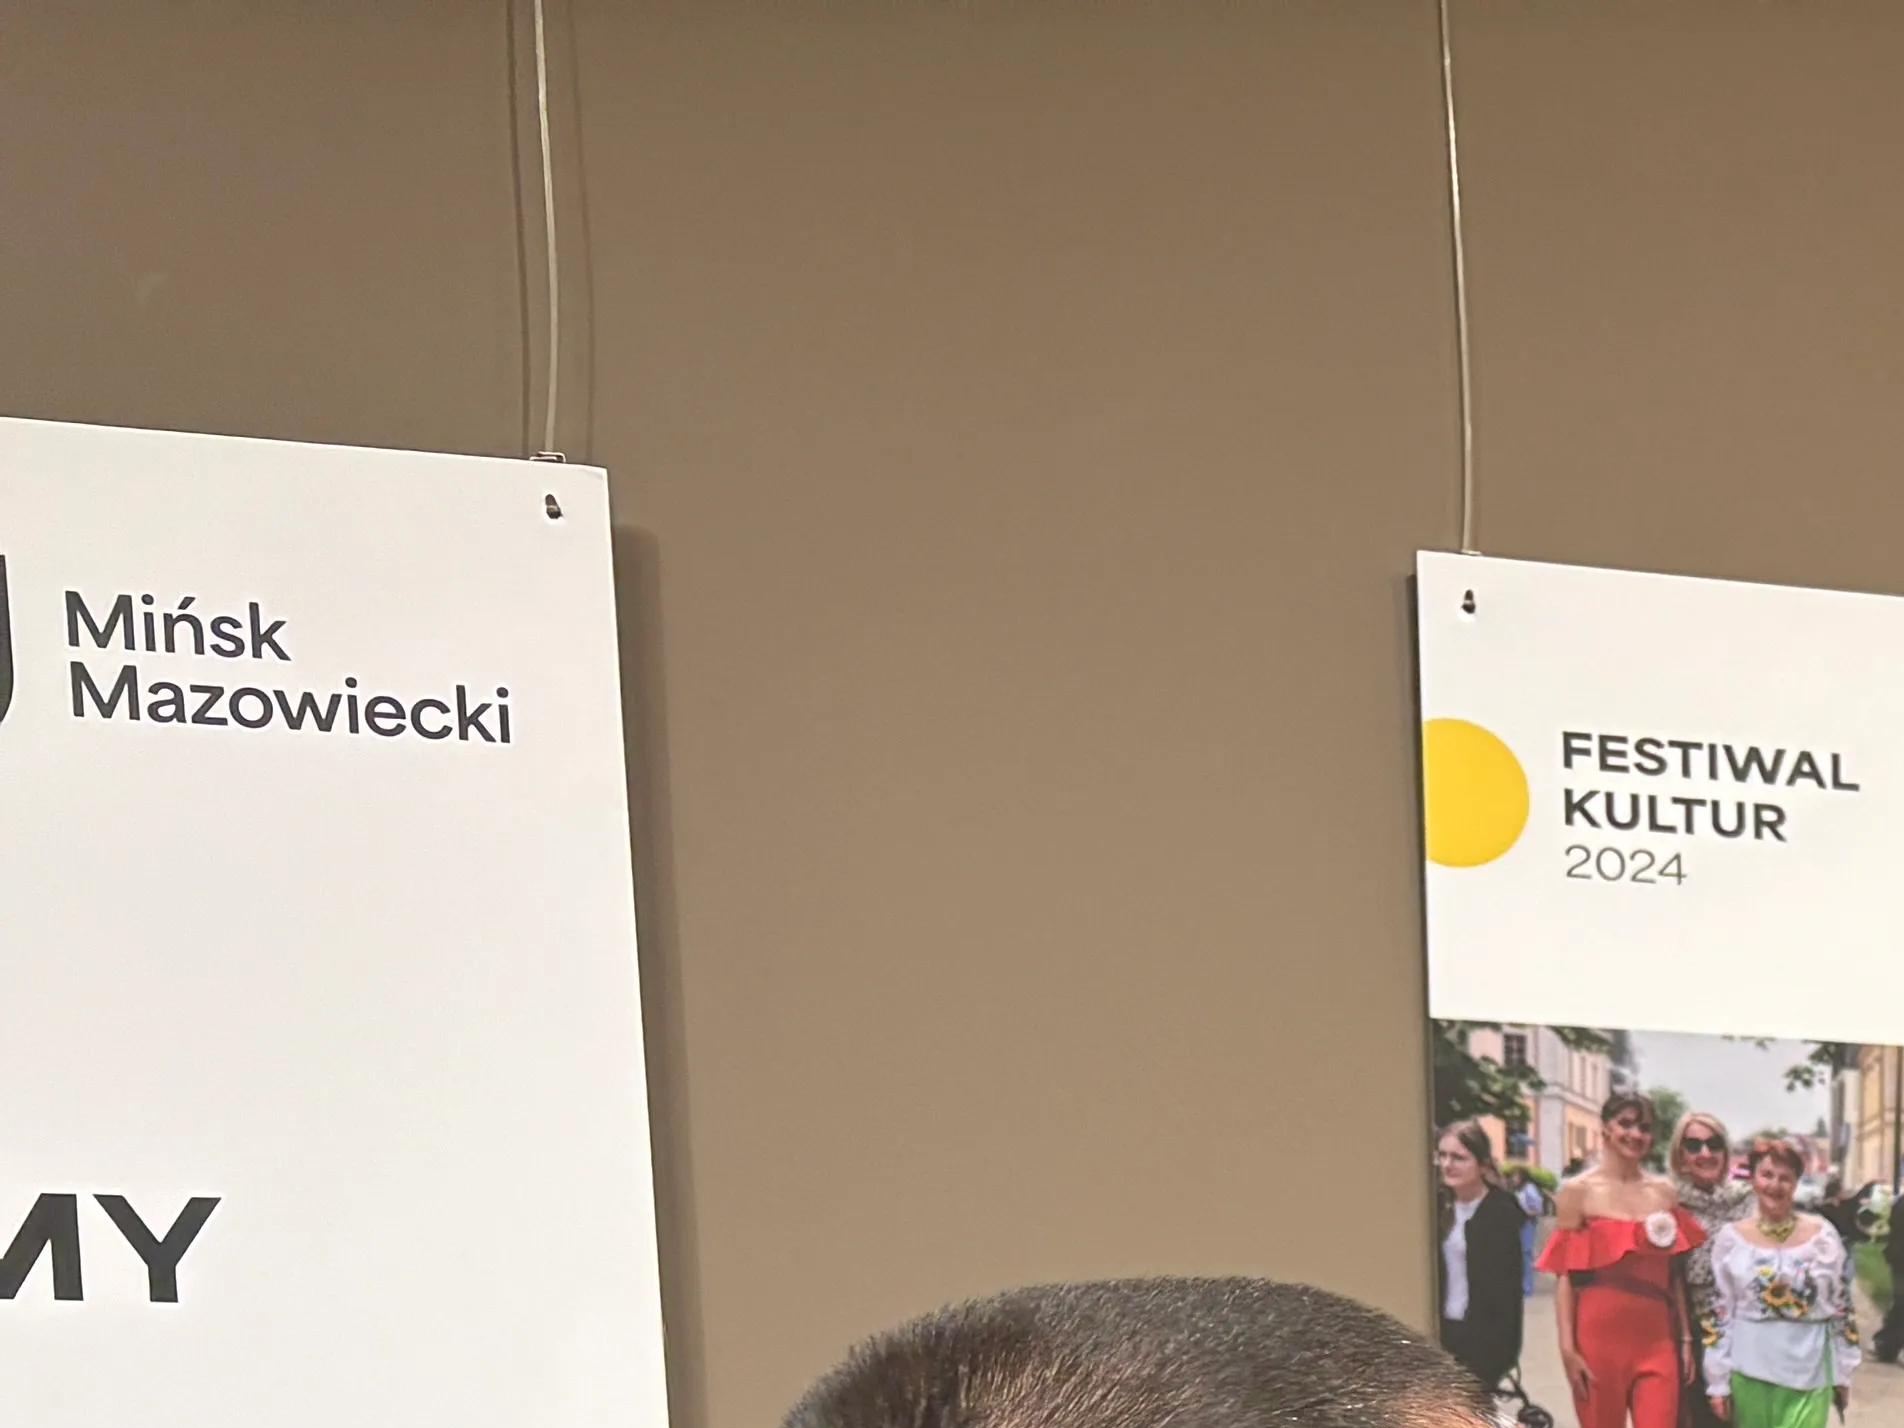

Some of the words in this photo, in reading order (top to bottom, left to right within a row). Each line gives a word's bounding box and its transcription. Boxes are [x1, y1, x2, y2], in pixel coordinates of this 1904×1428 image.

[65, 590, 291, 661] Mińsk
[70, 661, 512, 744] Mazowiecki
[1562, 731, 1860, 792] FESTIWAL
[1564, 788, 1787, 842] KULTUR
[1565, 844, 1687, 886] 2024
